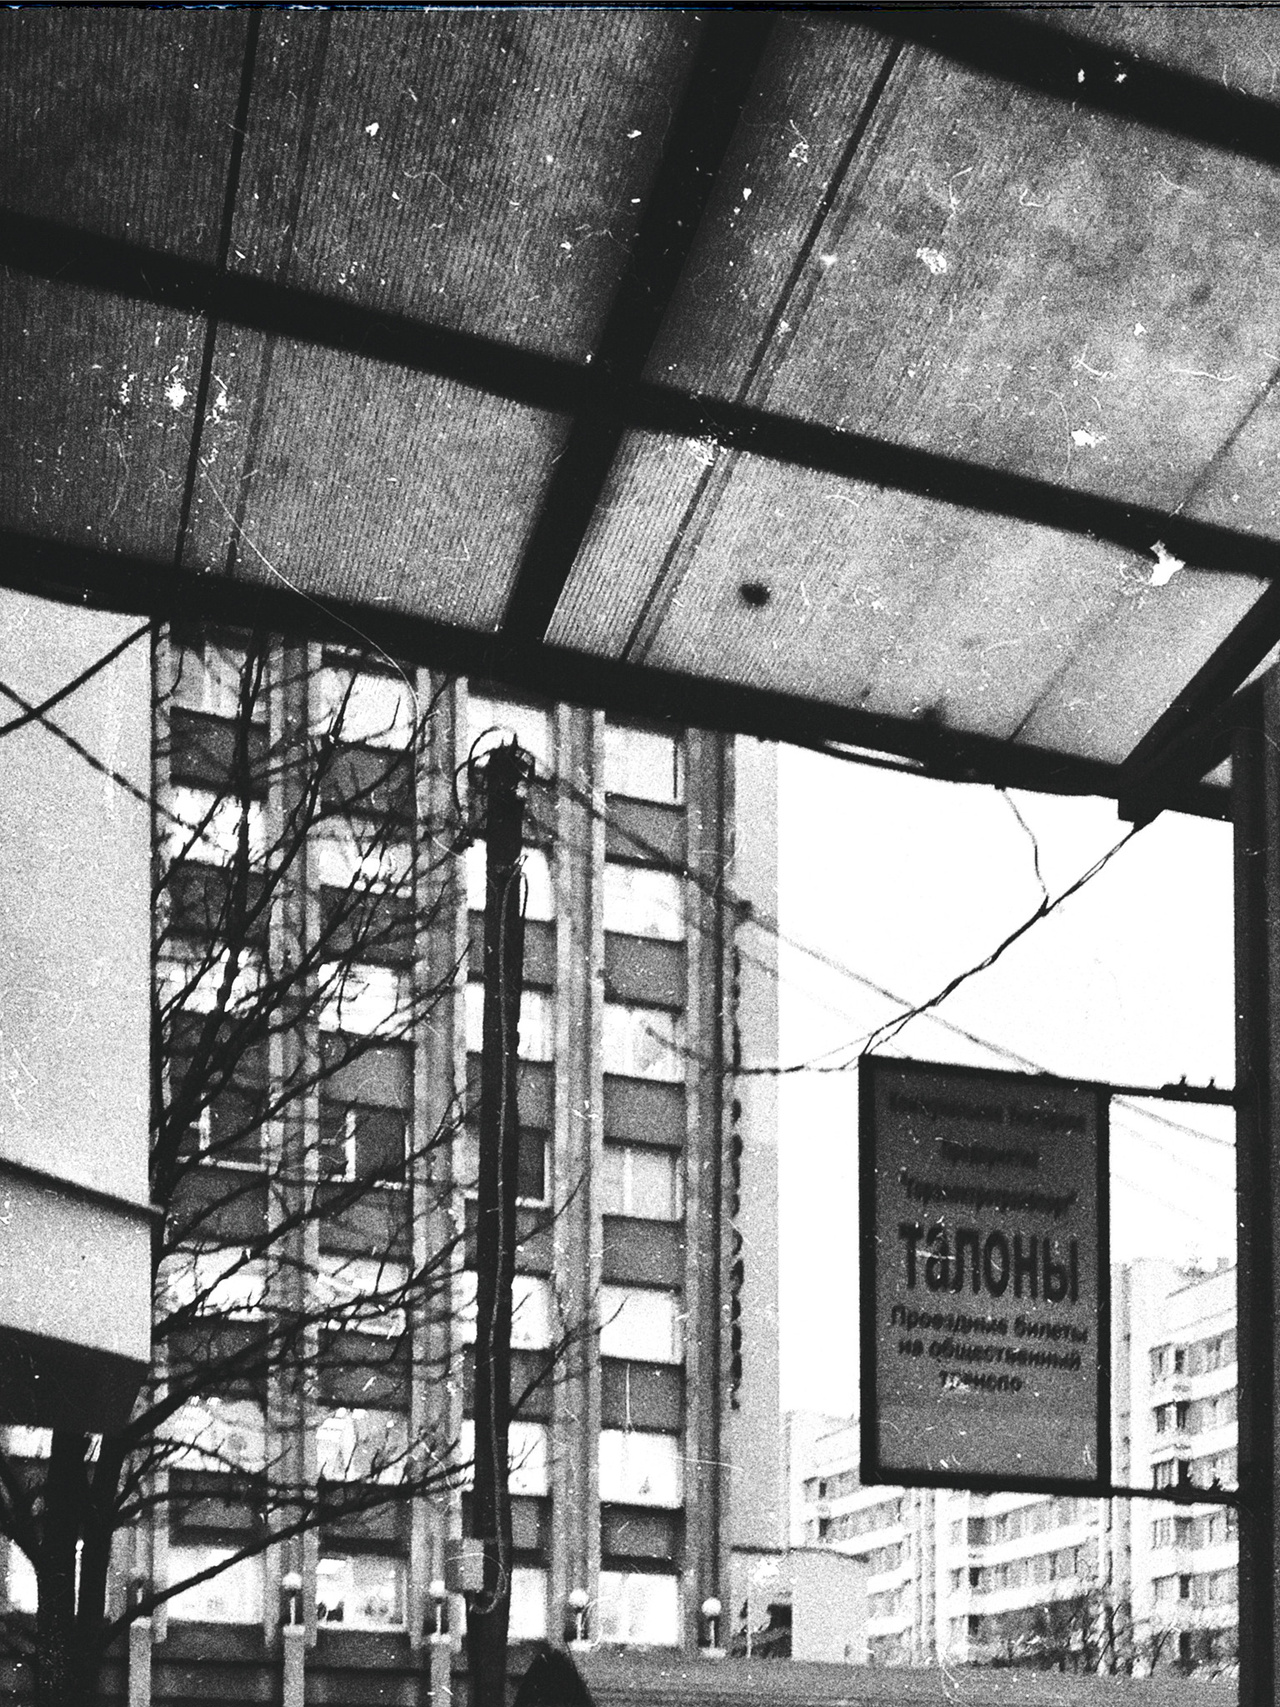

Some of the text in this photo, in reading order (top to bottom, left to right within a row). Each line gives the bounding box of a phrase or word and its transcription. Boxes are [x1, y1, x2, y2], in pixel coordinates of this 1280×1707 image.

[891, 1304, 1089, 1343] Проездные билеты
[898, 1338, 924, 1357] на
